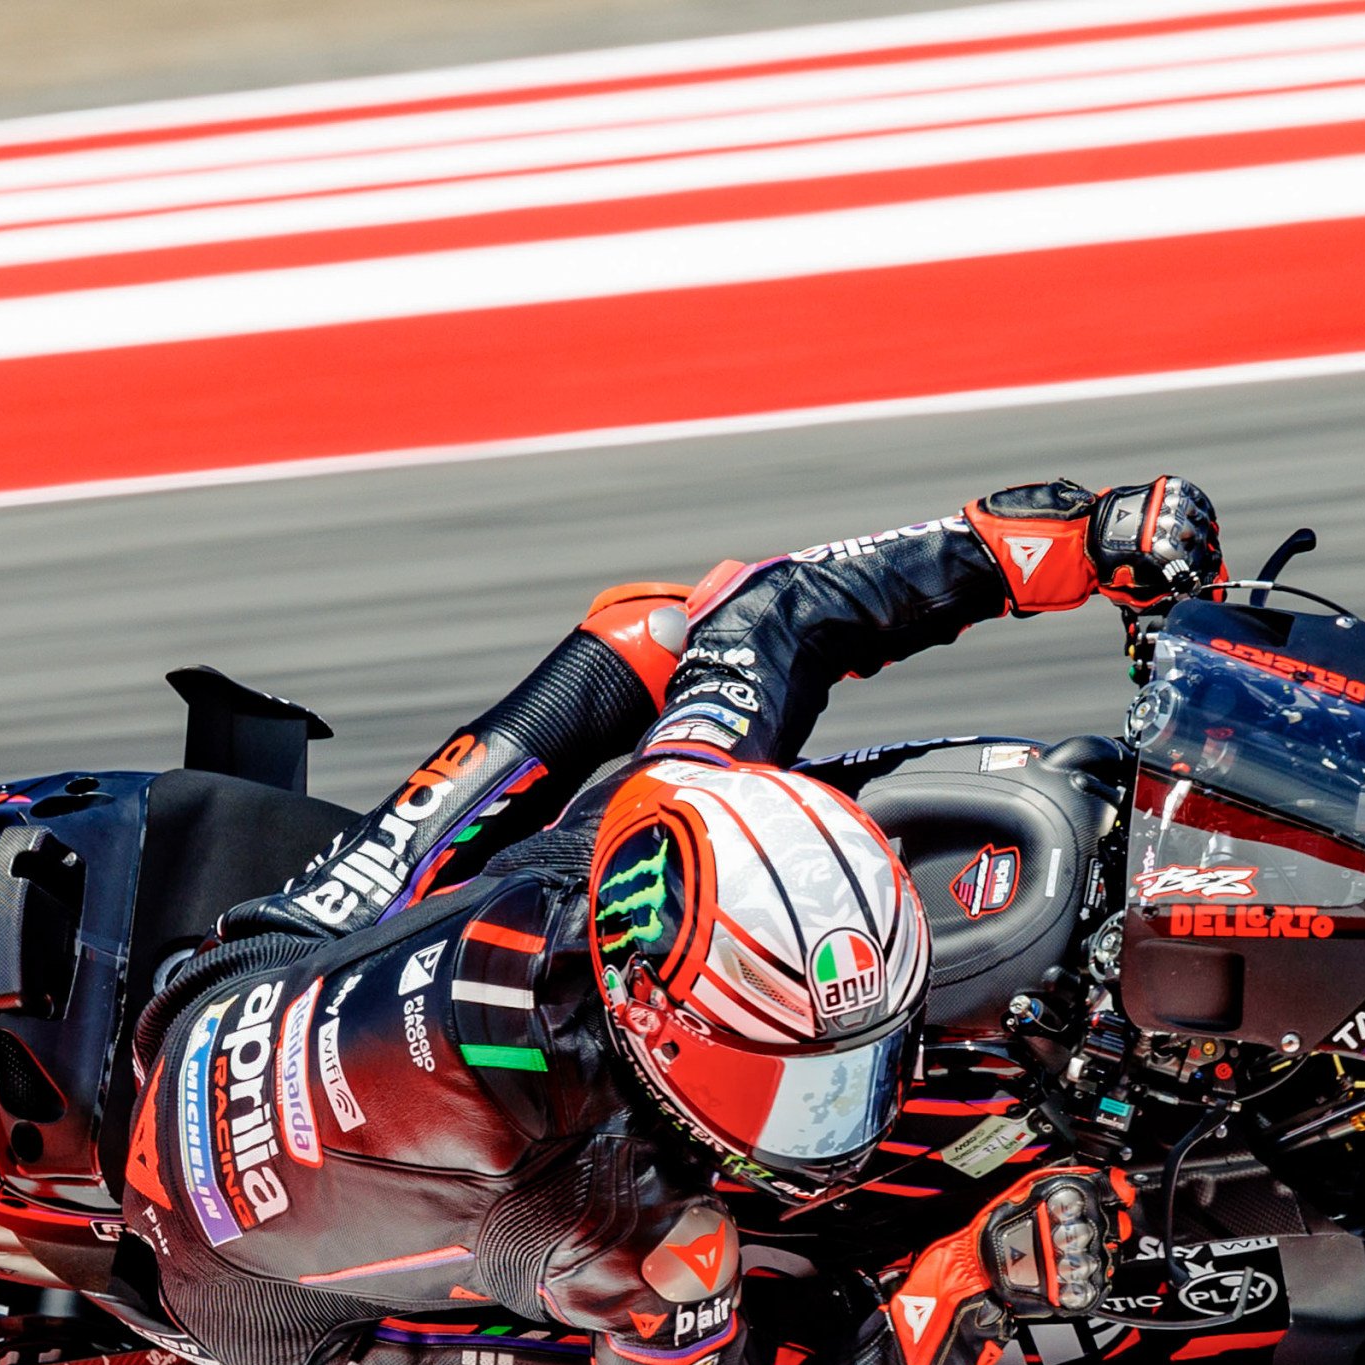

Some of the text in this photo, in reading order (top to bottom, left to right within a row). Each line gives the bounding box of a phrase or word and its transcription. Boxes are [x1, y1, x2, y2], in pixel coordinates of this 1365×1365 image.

[292, 734, 488, 925] aprilia
[825, 971, 876, 1011] agv
[1170, 905, 1335, 938] DELLORTO
[222, 981, 289, 1223] aprilia
[284, 990, 313, 1151] sterilgarda
[403, 999, 424, 1069] GROUP
[413, 994, 436, 1073] PIAGGIO
[186, 1060, 223, 1220] MICHELIN
[213, 1056, 257, 1230] RACING
